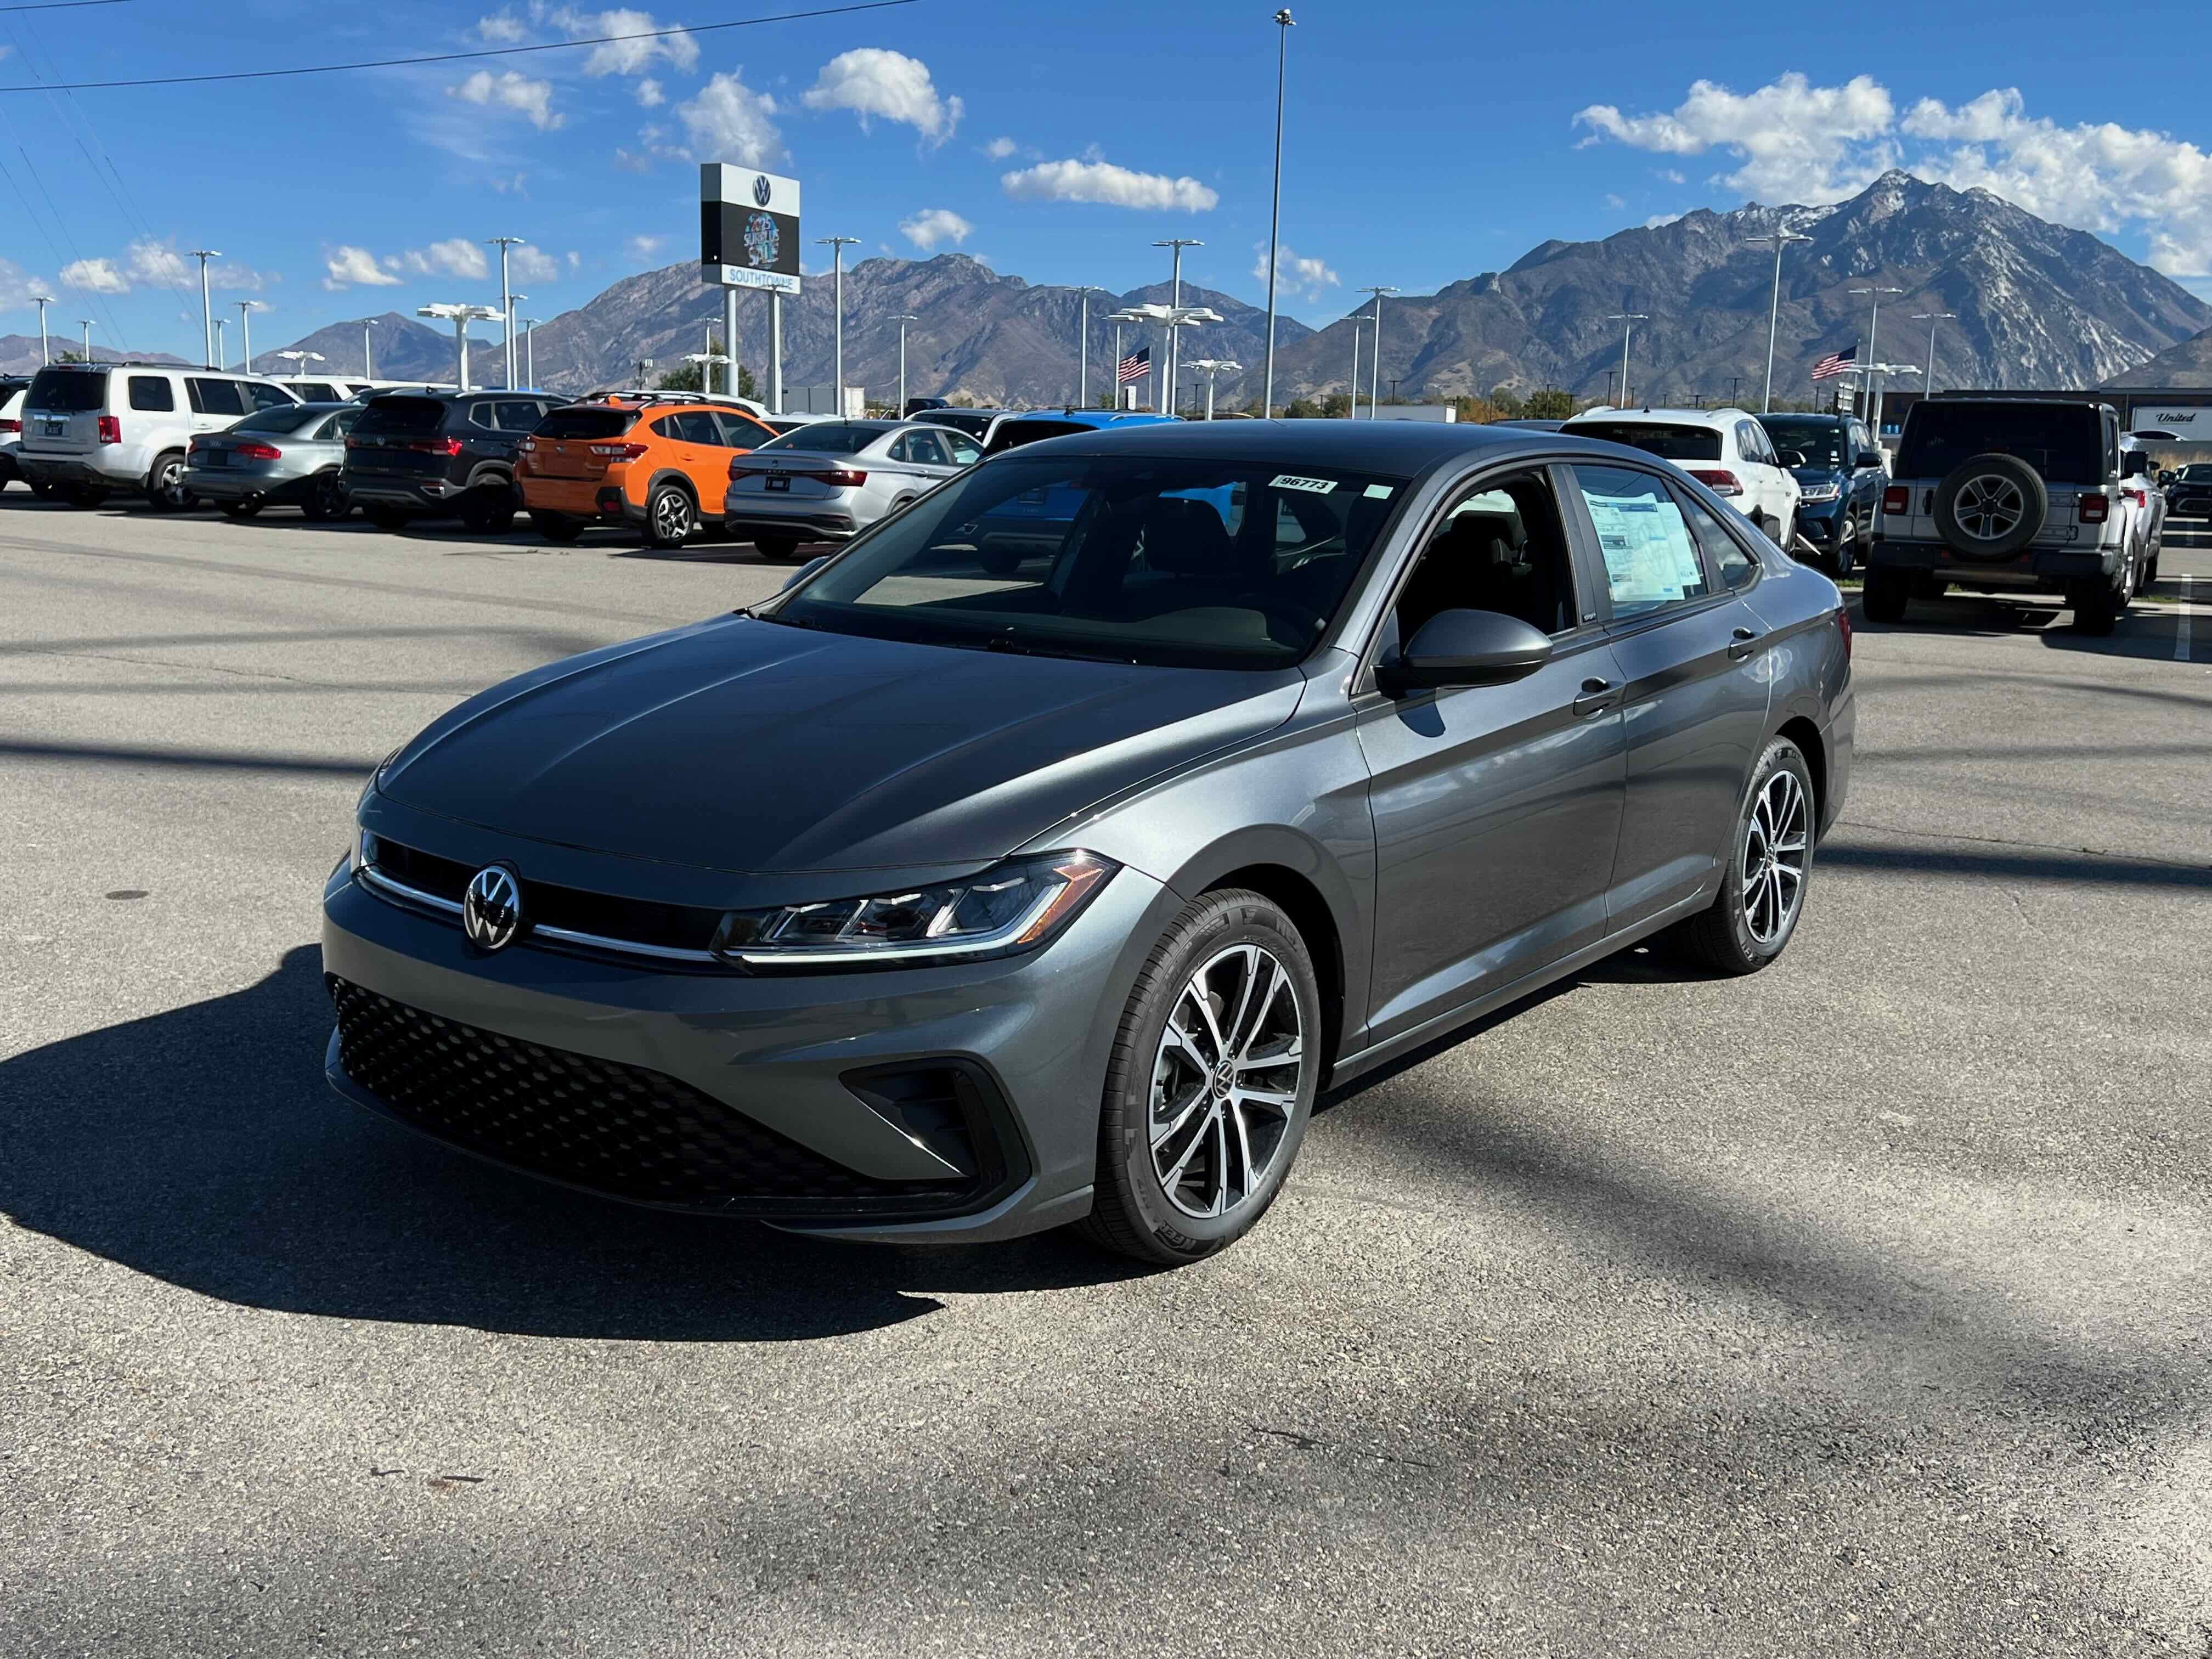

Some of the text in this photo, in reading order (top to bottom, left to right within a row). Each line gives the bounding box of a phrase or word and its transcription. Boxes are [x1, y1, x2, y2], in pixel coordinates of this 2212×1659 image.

[754, 176, 771, 206] VW
[730, 269, 793, 289] SOUTHTOWNE
[2155, 413, 2197, 424] United
[1280, 477, 1329, 489] 96773
